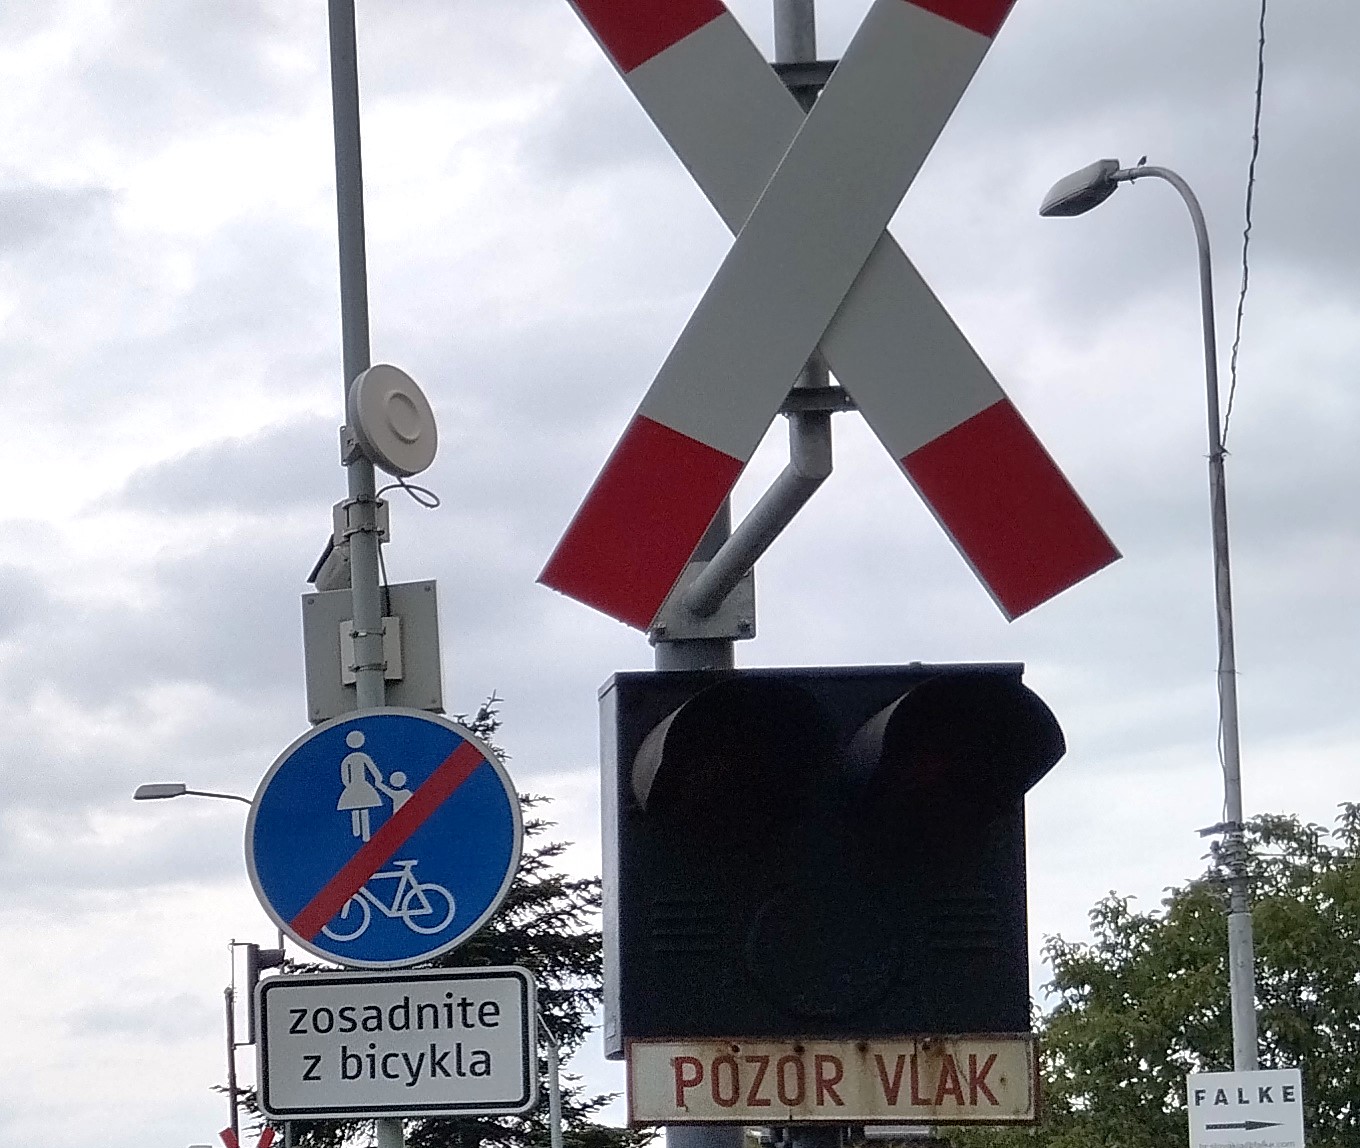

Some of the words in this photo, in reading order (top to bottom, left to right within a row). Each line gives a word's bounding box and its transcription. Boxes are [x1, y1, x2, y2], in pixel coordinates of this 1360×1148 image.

[289, 991, 500, 1034] zosadnite
[302, 1054, 321, 1080] z
[341, 1042, 491, 1087] bicykla
[673, 1054, 845, 1108] POZOR
[875, 1053, 1000, 1107] VLAK
[1194, 1085, 1295, 1106] FALKE
